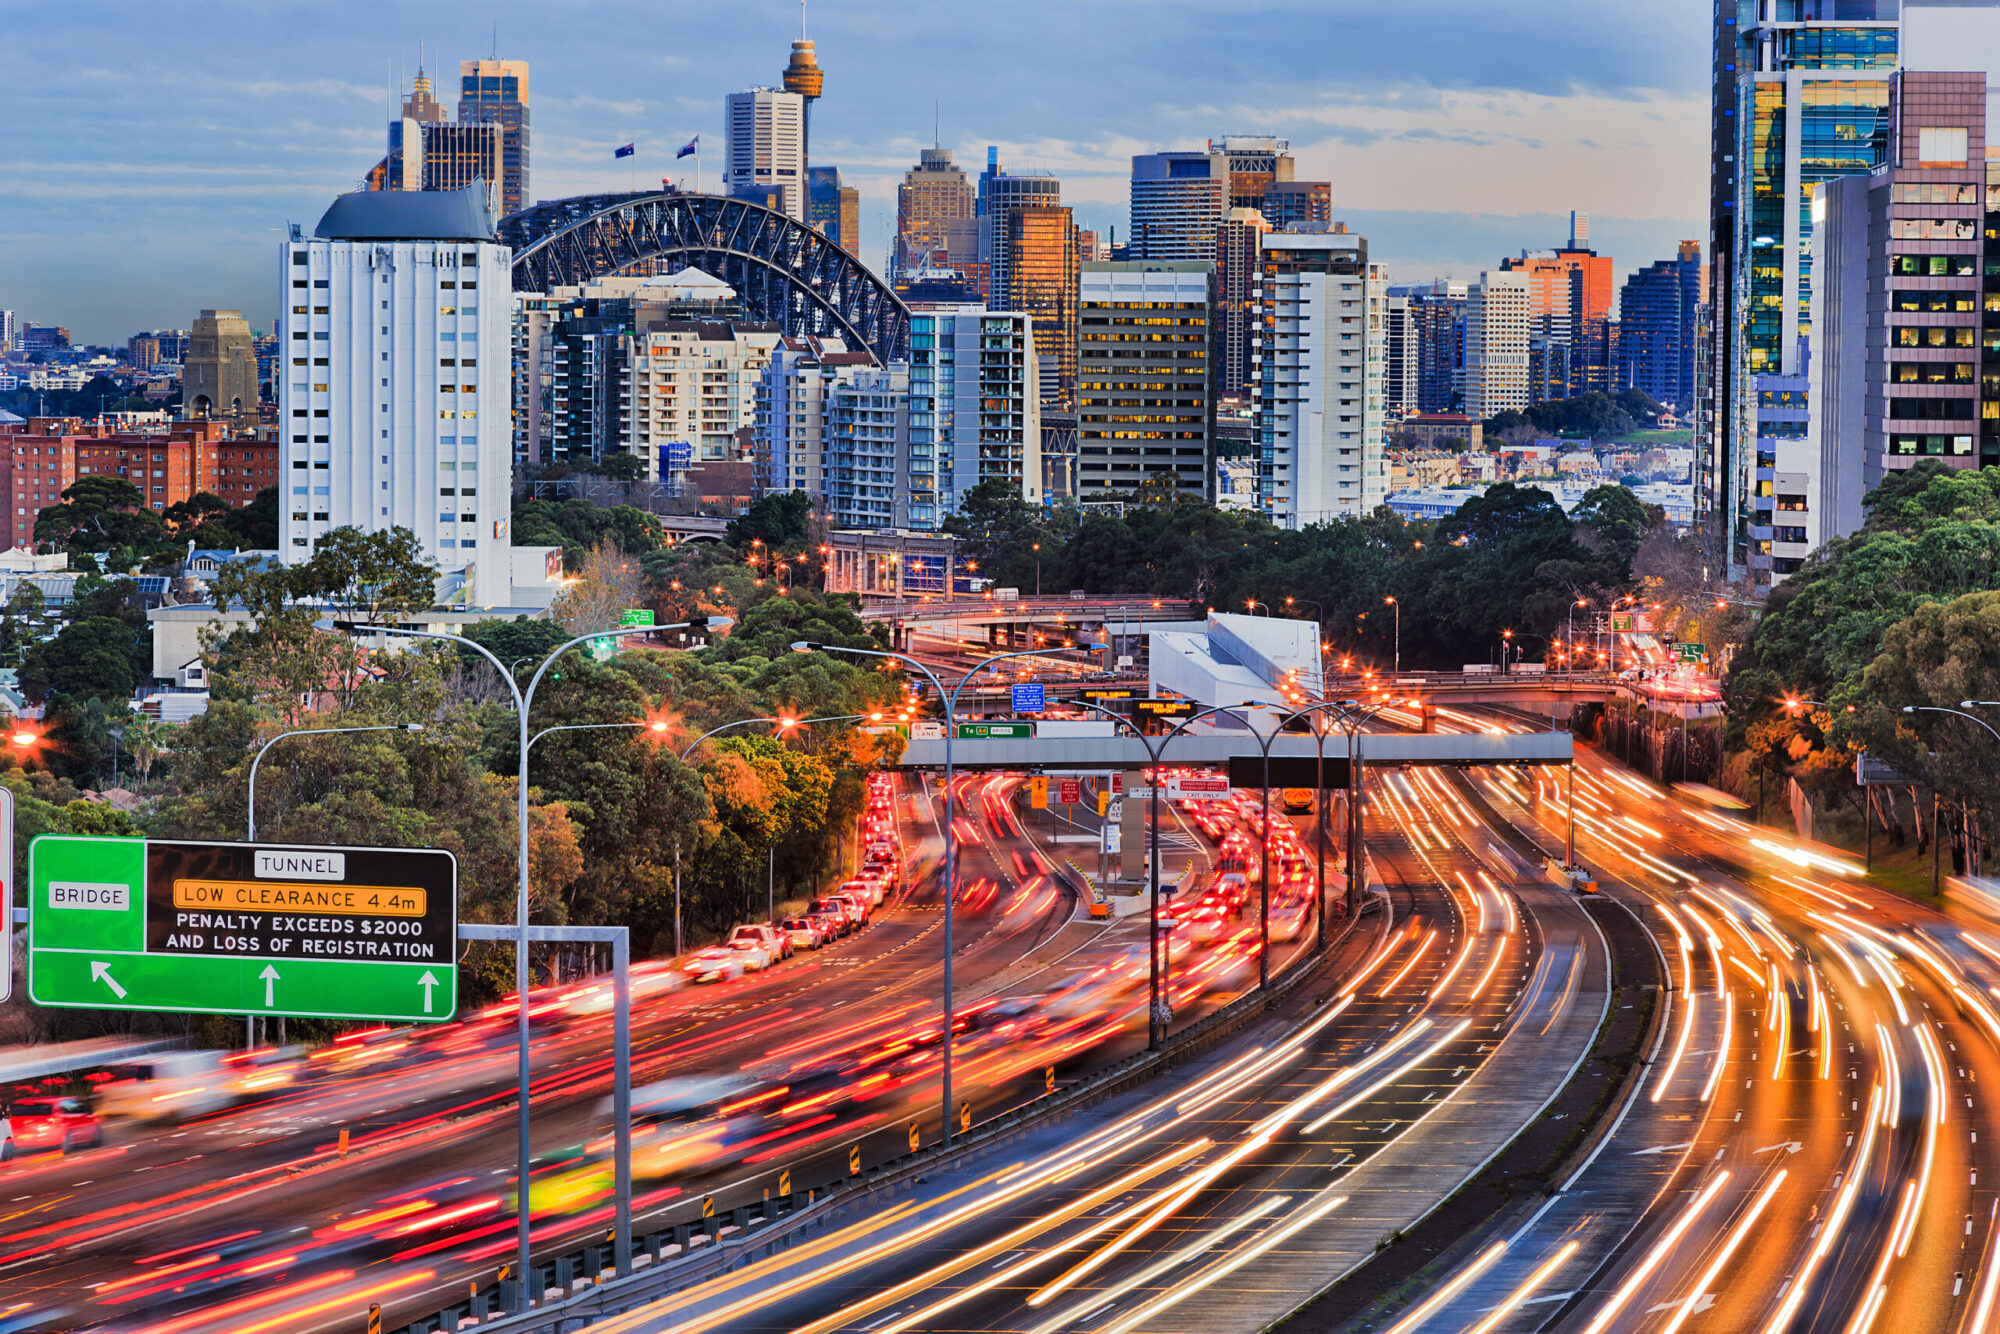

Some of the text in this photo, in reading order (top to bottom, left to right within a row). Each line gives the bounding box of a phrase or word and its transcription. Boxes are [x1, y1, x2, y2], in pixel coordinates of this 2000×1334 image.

[261, 857, 338, 873] TUNNEL
[55, 888, 123, 904] BRIDGE
[184, 887, 415, 909] LOW CLEARANCE 4.4m
[177, 913, 422, 936] PENALTY EXCEEDS $2000
[166, 934, 434, 957] AND LOSS OF REGISTRATION
